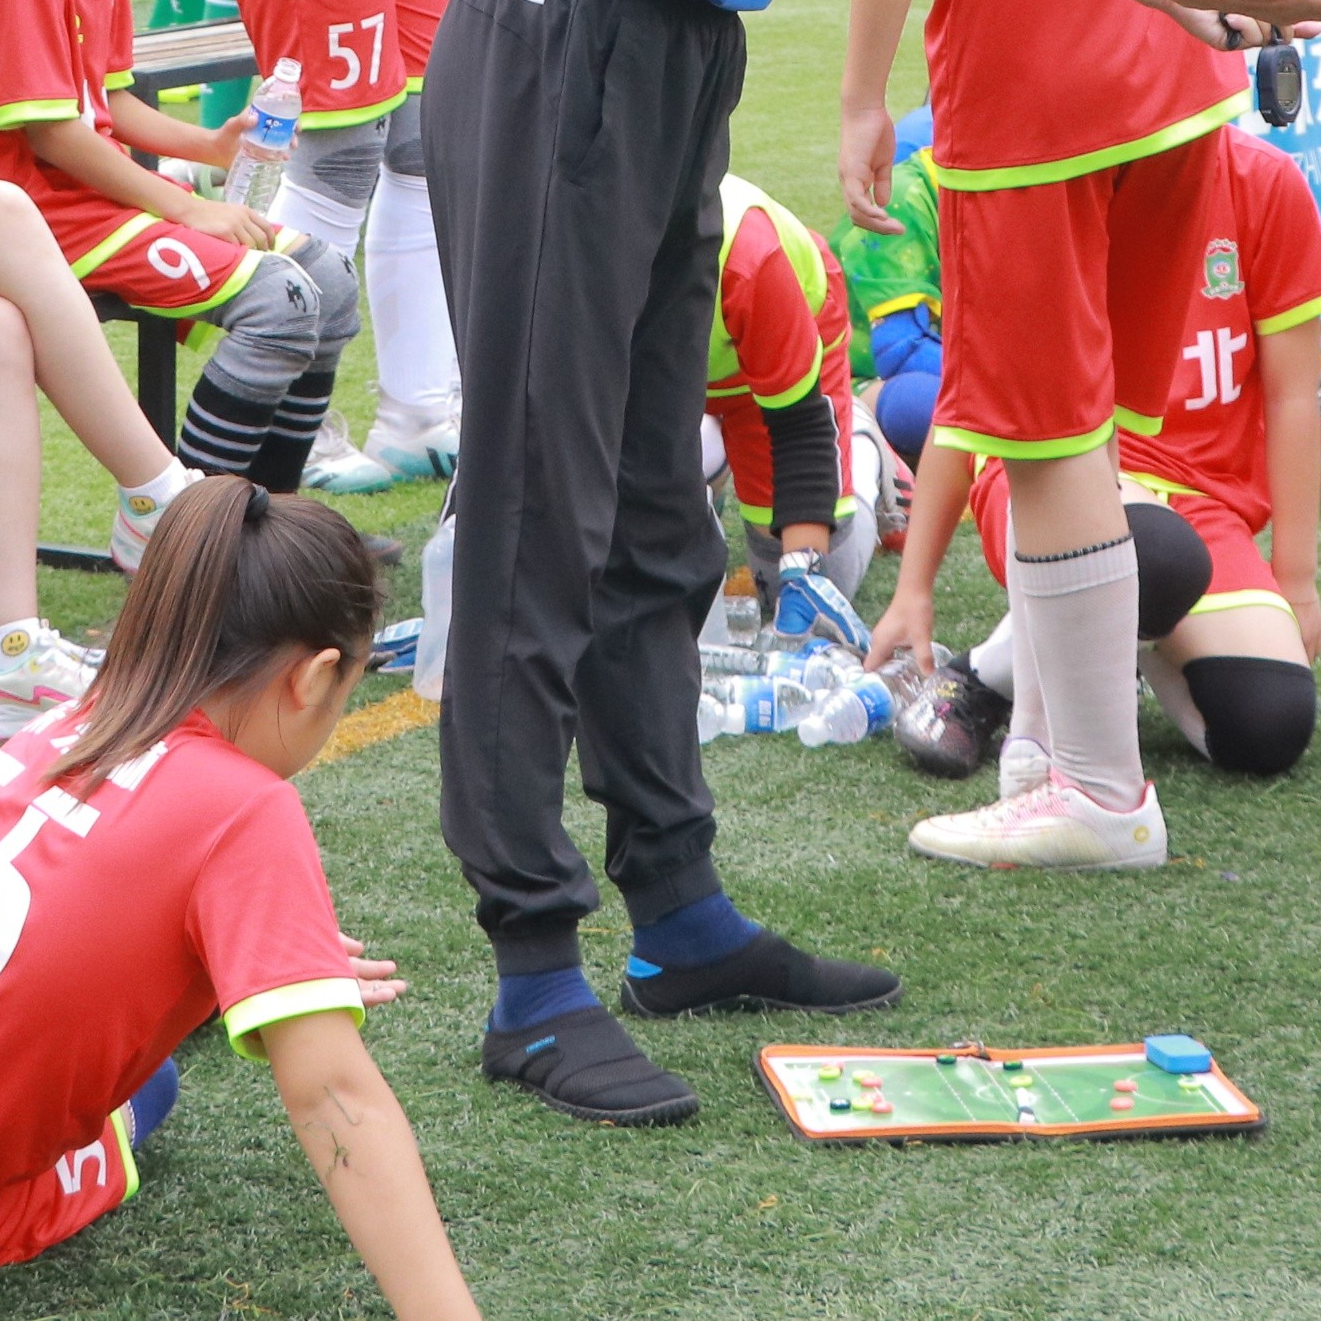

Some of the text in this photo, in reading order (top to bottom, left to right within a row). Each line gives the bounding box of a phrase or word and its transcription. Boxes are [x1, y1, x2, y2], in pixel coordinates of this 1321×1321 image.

[328, 13, 384, 90] 57
[147, 237, 210, 290] 9
[1183, 327, 1247, 410] 北
